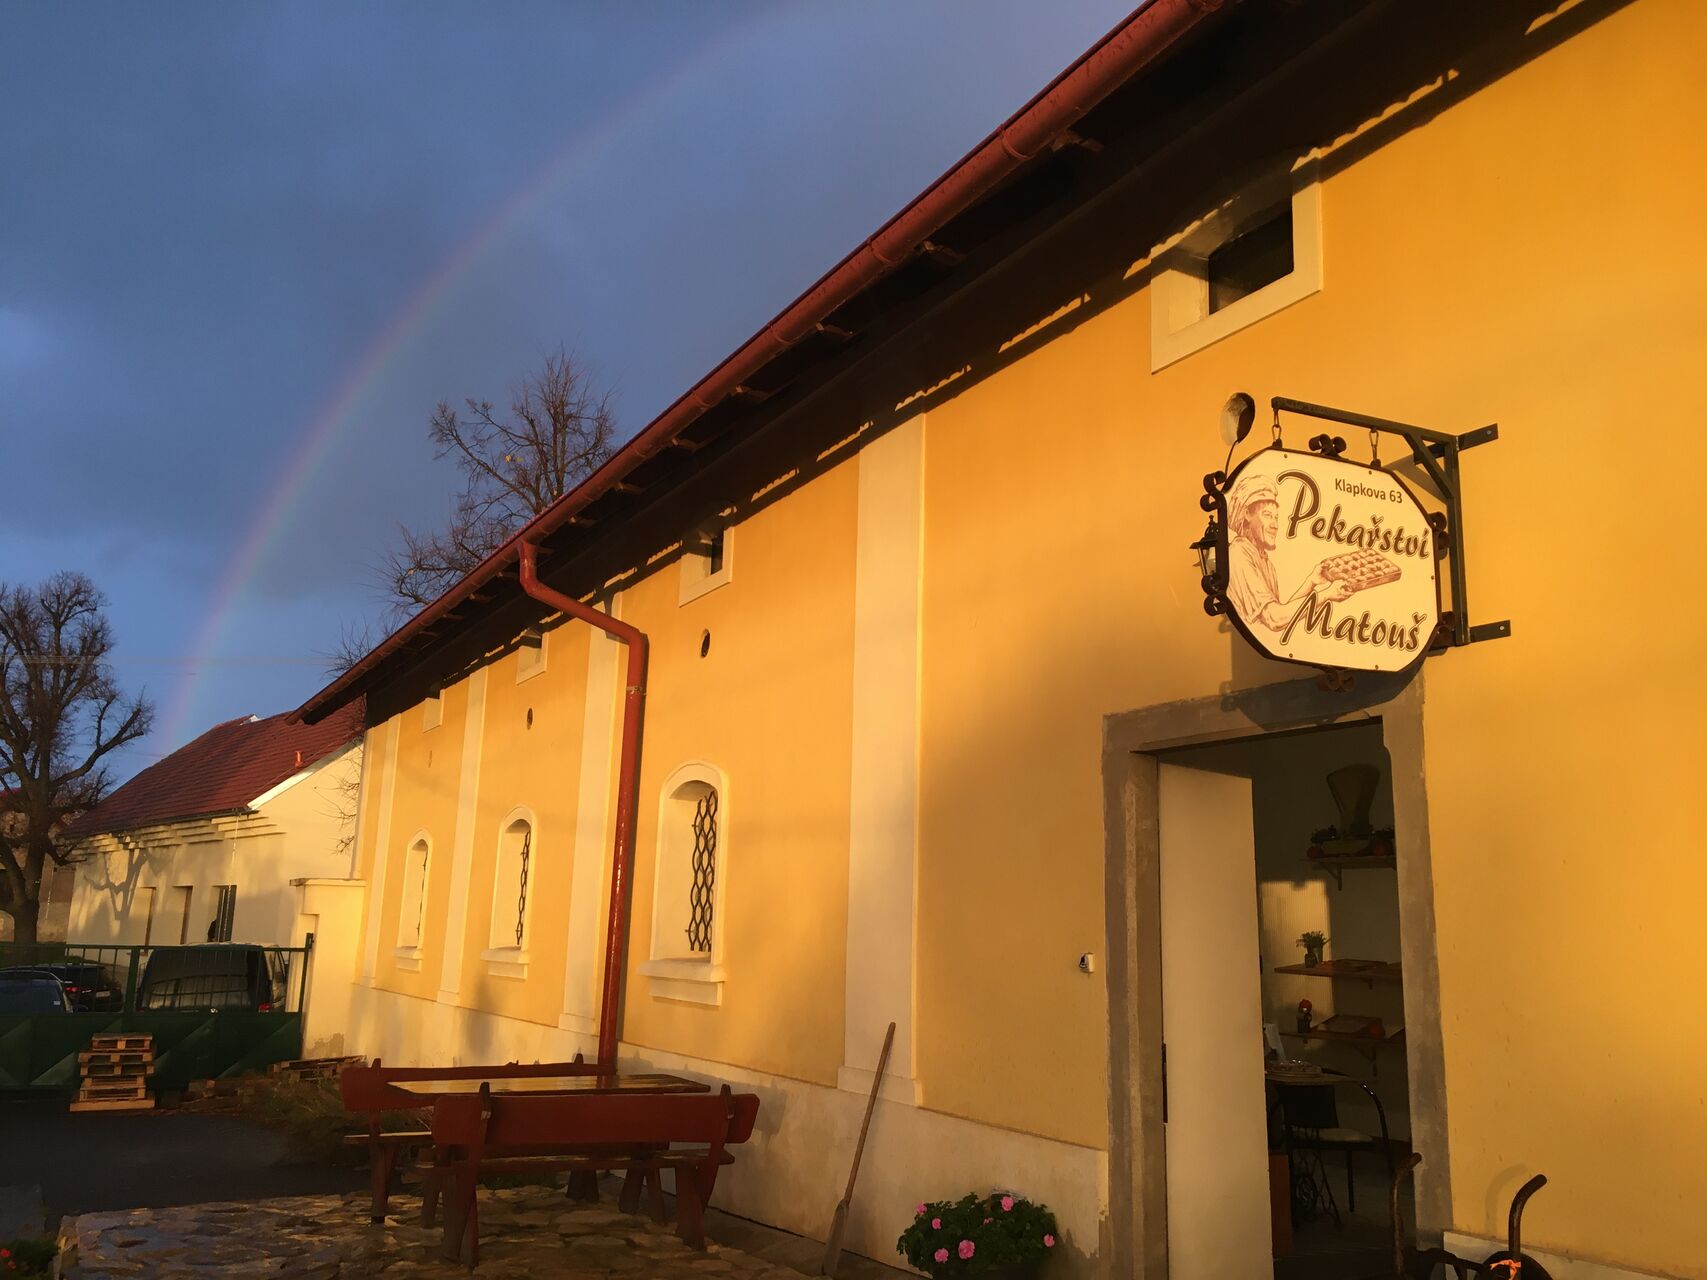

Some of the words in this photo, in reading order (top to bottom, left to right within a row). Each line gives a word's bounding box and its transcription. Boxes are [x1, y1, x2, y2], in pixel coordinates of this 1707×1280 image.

[1277, 470, 1431, 559] Pekařství
[1335, 478, 1386, 500] Klapkova
[1389, 489, 1403, 504] 63
[1280, 590, 1427, 652] Matouš
